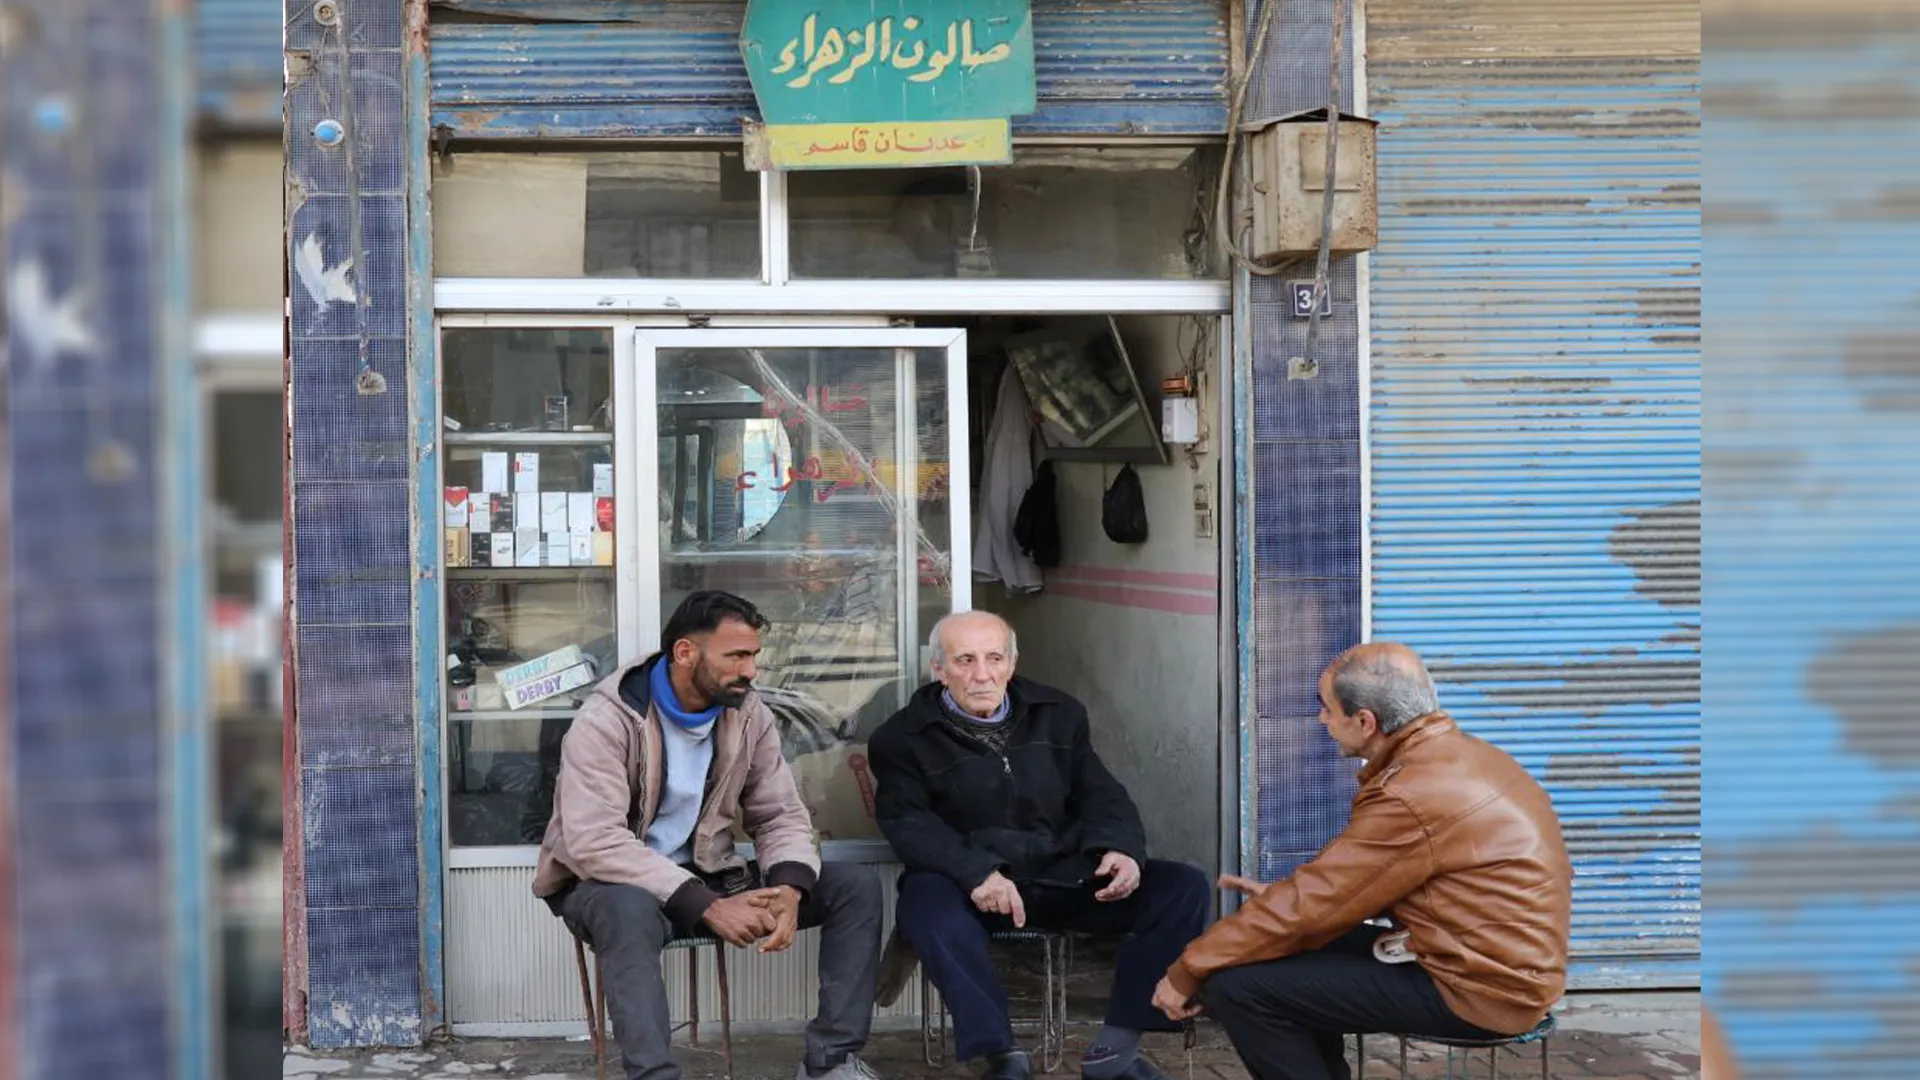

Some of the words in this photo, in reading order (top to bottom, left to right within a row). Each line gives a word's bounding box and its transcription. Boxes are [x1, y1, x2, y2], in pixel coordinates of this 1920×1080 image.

[771, 14, 892, 88] الزهراء
[892, 16, 1010, 81] صالون
[802, 127, 869, 156] قاسم
[874, 128, 966, 153] عدنان
[516, 675, 562, 704] DERBY
